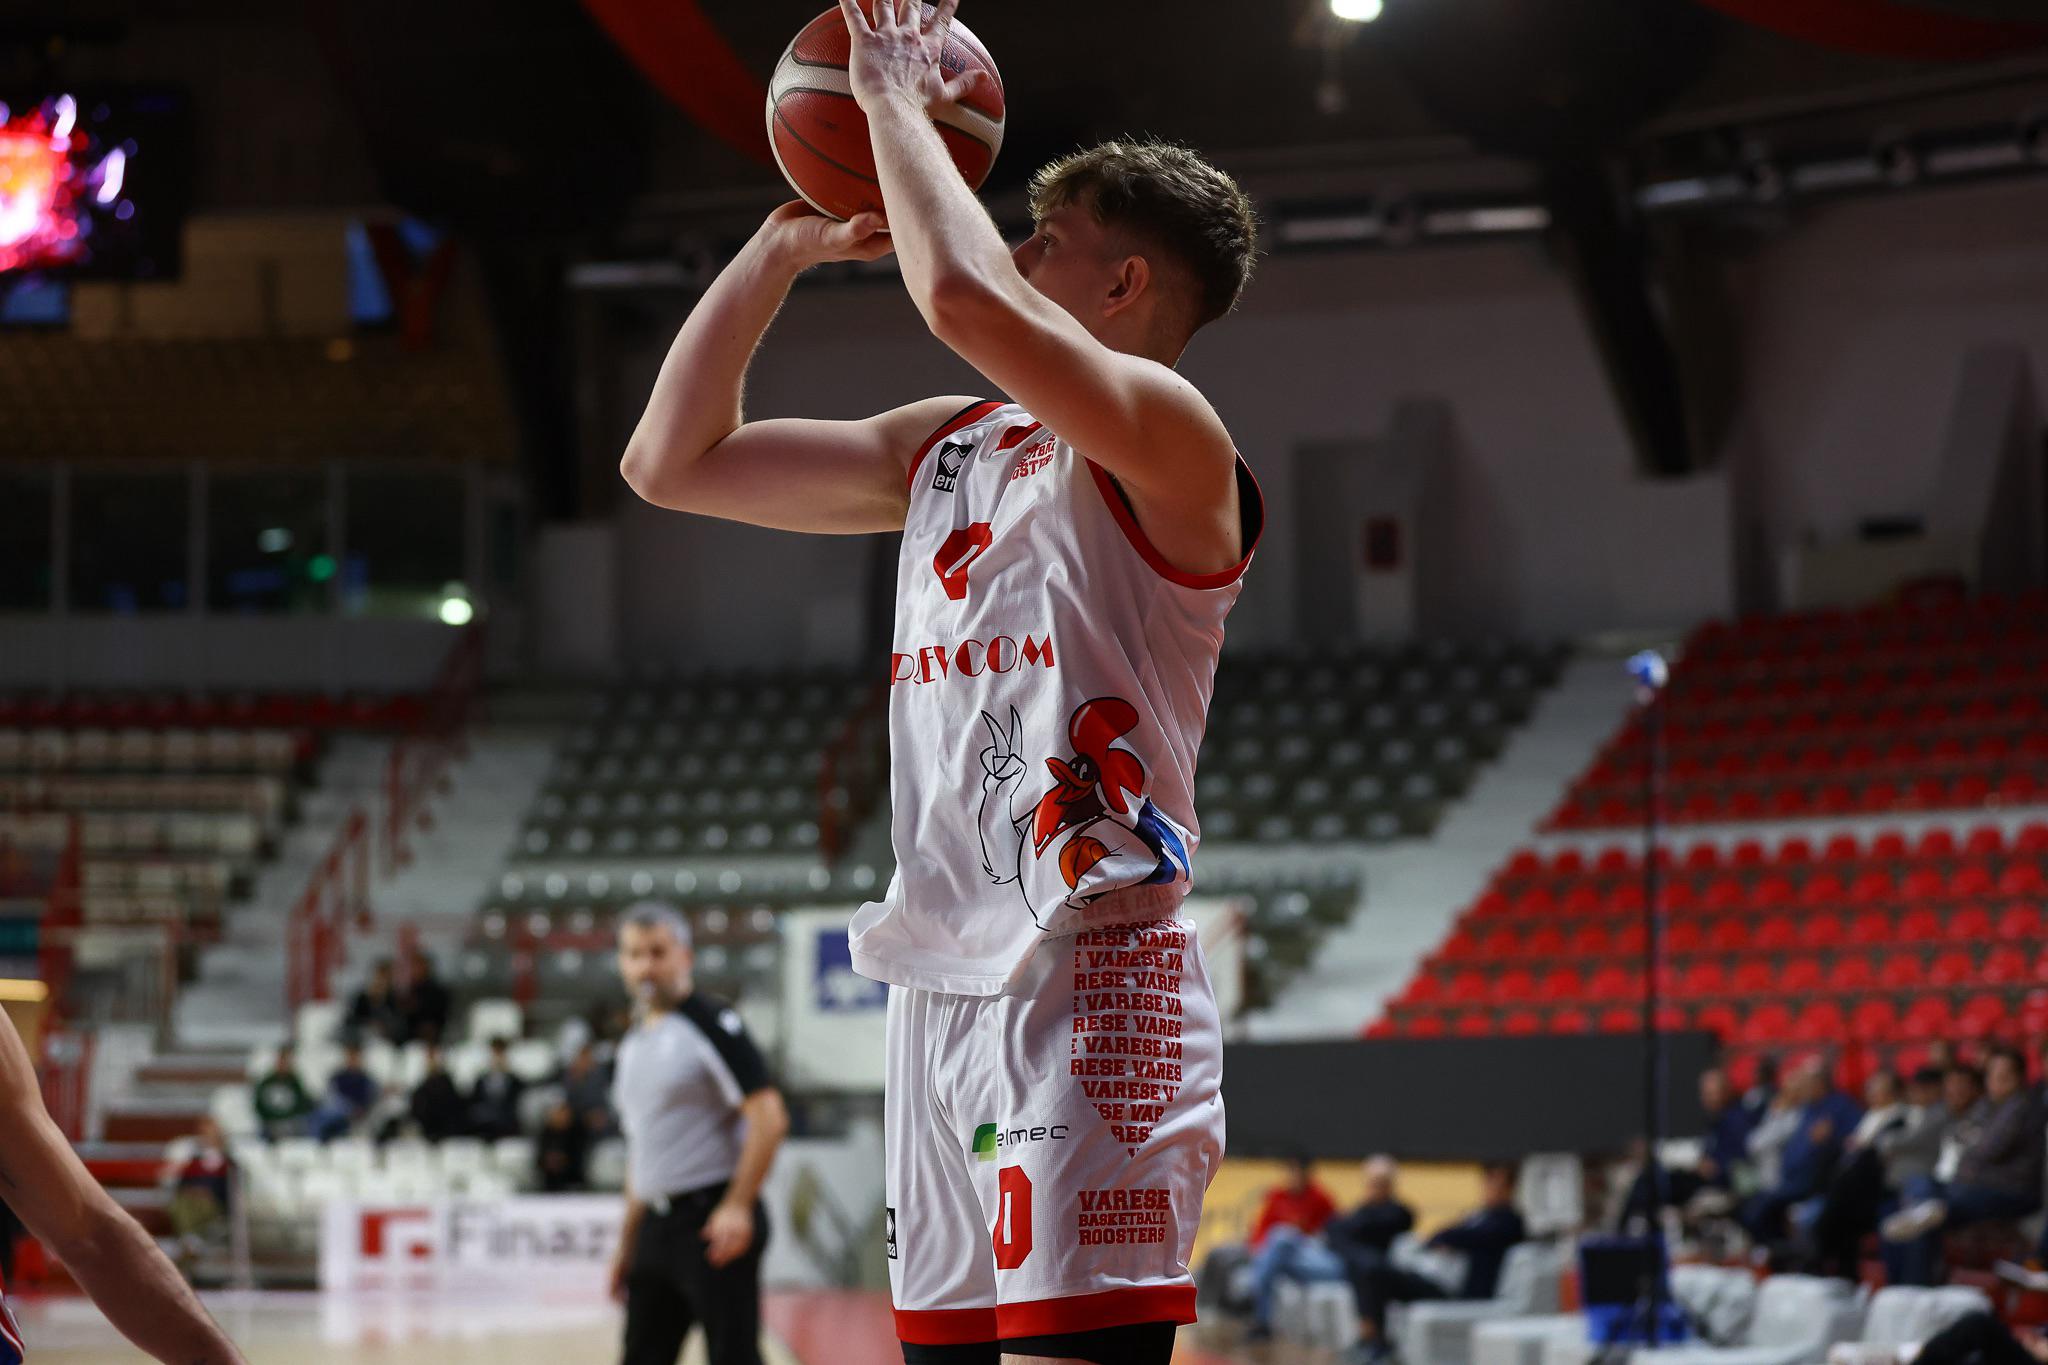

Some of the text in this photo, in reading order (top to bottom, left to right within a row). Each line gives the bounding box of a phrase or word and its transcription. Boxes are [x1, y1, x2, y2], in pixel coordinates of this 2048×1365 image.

[1087, 951, 1163, 968] VARESE
[1074, 971, 1127, 990] RESE
[1085, 993, 1163, 1012] VARESE
[1073, 1014, 1127, 1033] RESE
[1083, 1037, 1161, 1056] VARESE
[1071, 1059, 1126, 1076] RESE
[1081, 1081, 1160, 1100] VARESE
[1092, 1103, 1124, 1120] SE
[997, 1125, 1069, 1147] elmec
[1111, 1126, 1153, 1143] RES
[1078, 1189, 1170, 1211] VARESE
[993, 1165, 1033, 1270] 0
[1079, 1212, 1166, 1227] BASKETBALL
[1079, 1227, 1165, 1245] ROOSTERS
